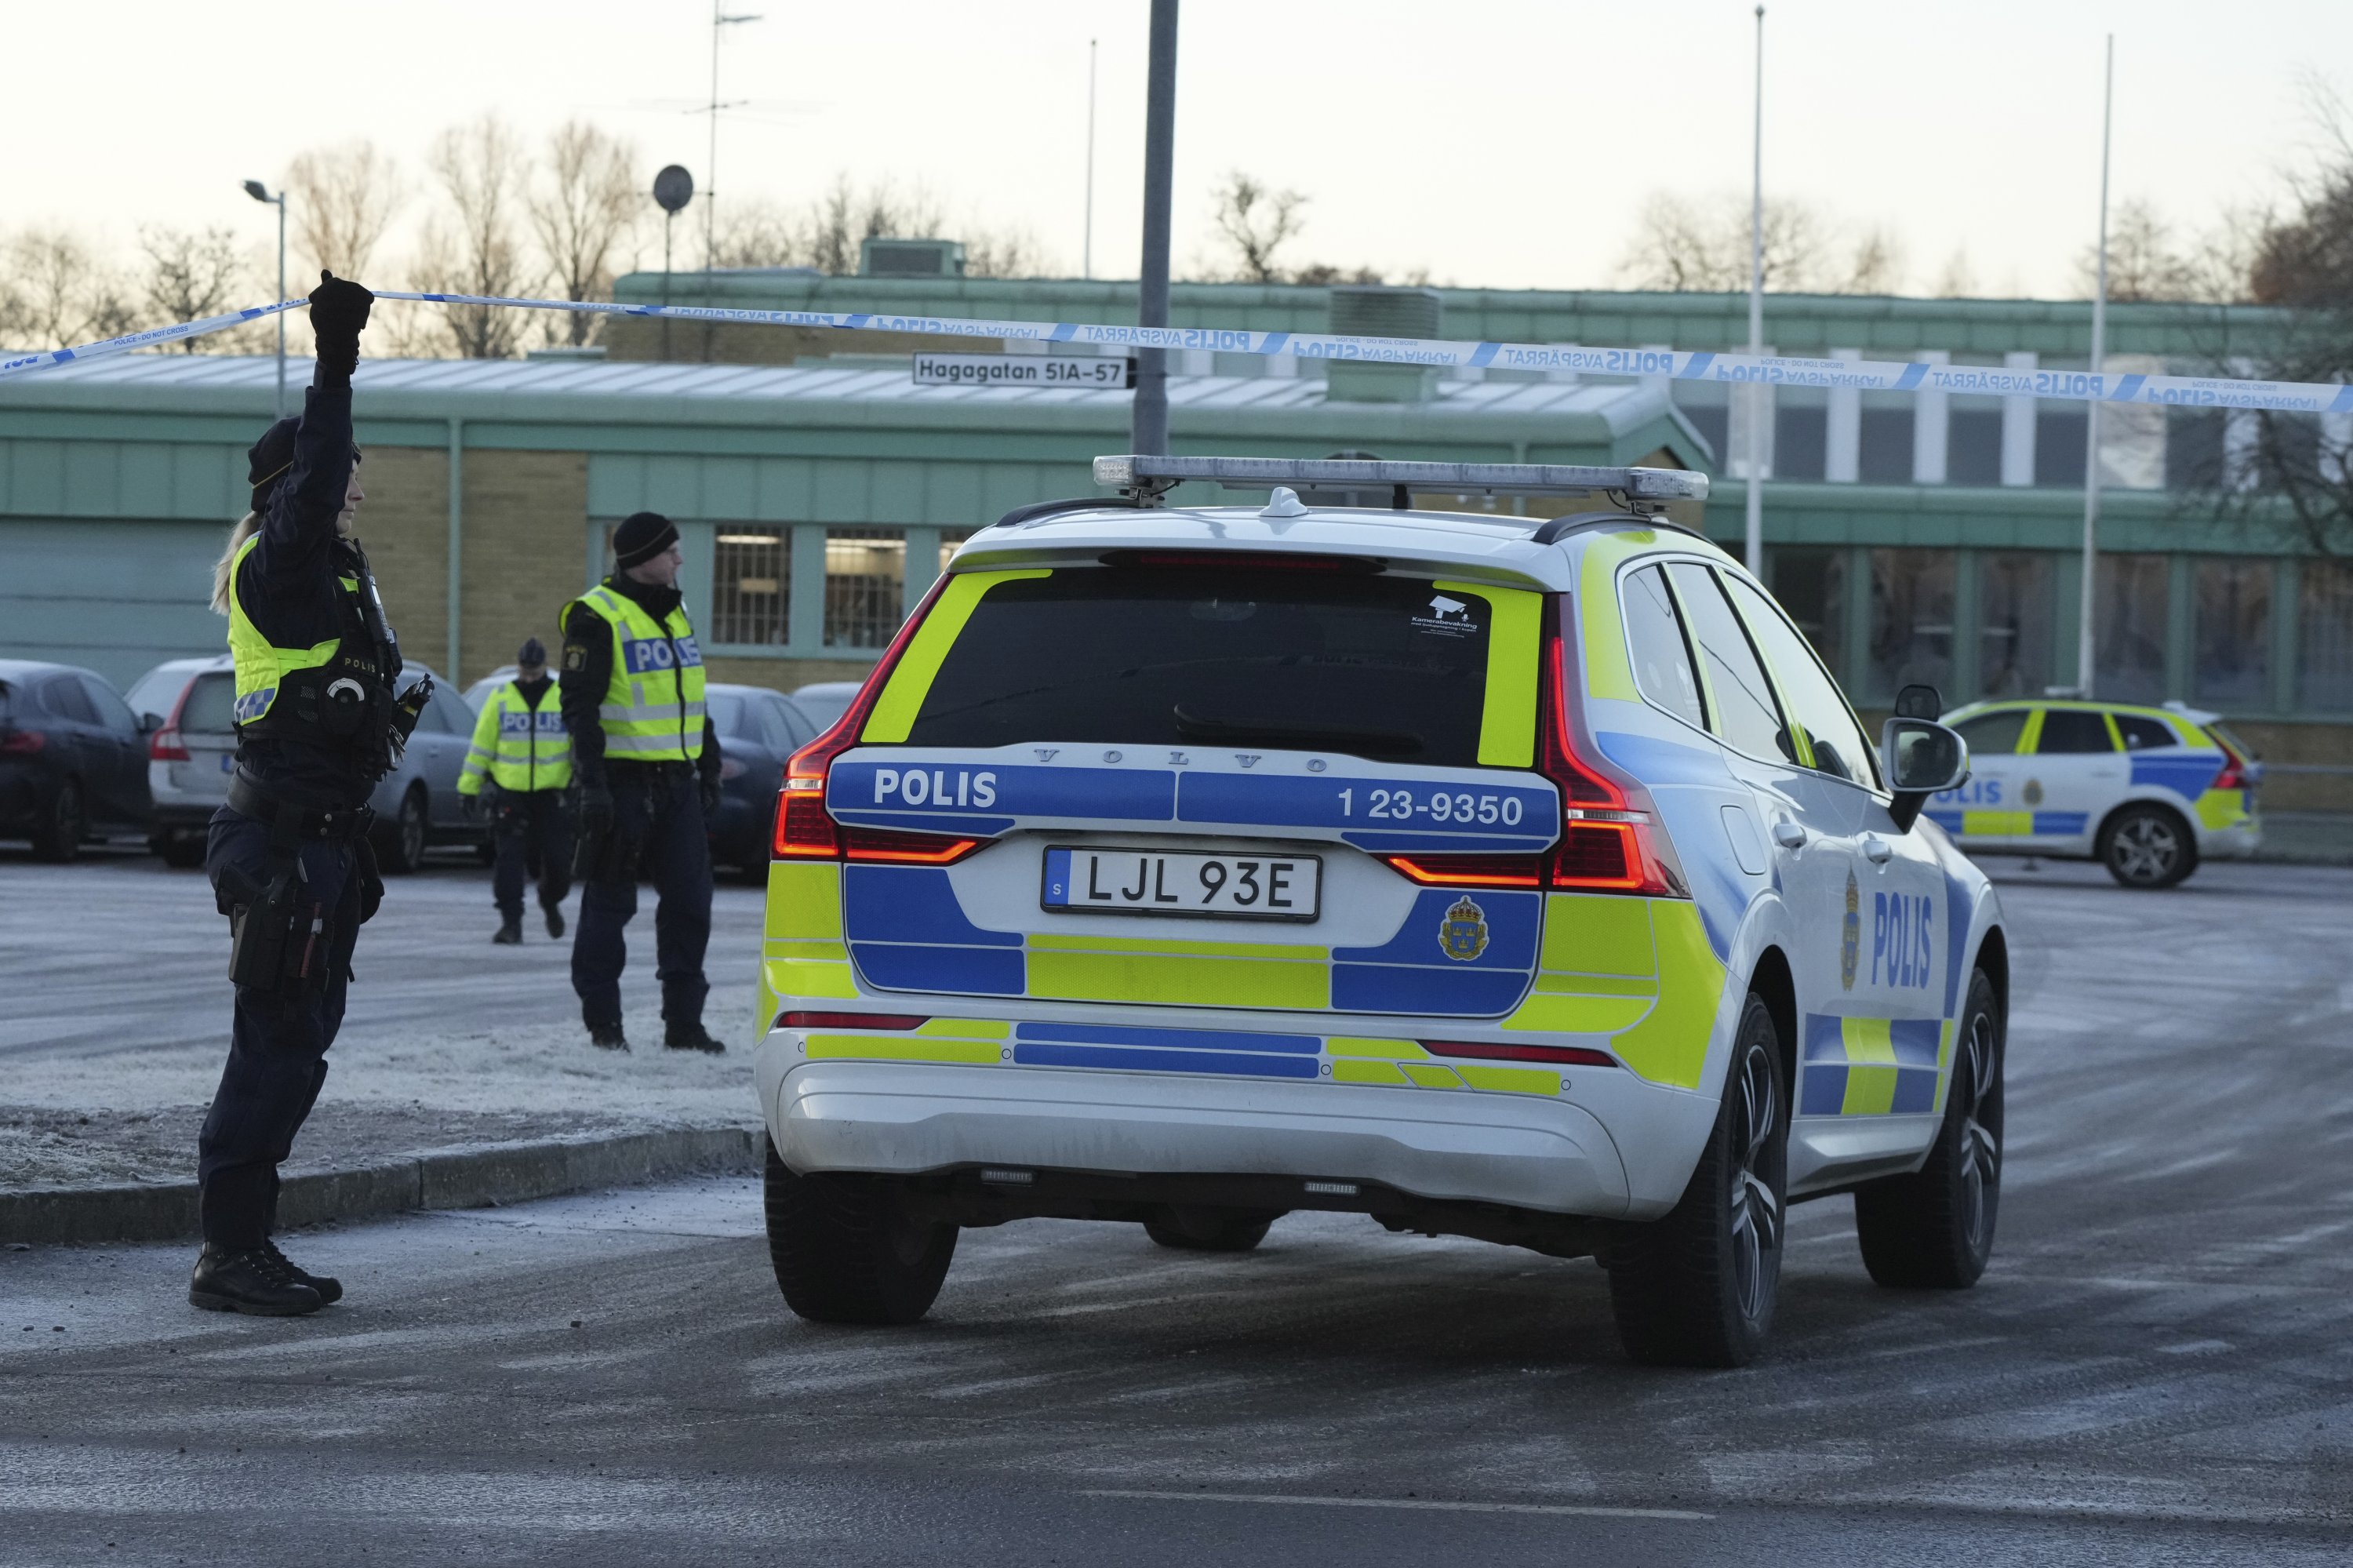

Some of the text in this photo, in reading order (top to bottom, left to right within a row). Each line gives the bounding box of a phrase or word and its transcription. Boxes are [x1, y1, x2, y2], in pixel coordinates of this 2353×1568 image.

[114, 336, 136, 346] POLICE
[152, 329, 165, 338] NOT
[166, 326, 188, 335] CROSS
[919, 360, 1121, 382] Hagagatan 51A-57
[1412, 617, 1478, 630] Kamerabevakning
[344, 657, 376, 673] POLIS
[635, 637, 702, 671] POLIS
[504, 712, 562, 733] POLIS
[1034, 748, 1327, 772] VOLVO
[875, 769, 996, 808] POLIS
[1934, 780, 2003, 803] OLIS
[1338, 788, 1522, 826] 1 23-9350
[1053, 856, 1294, 908] S LJL 93E
[1871, 891, 1932, 990] POLIS
